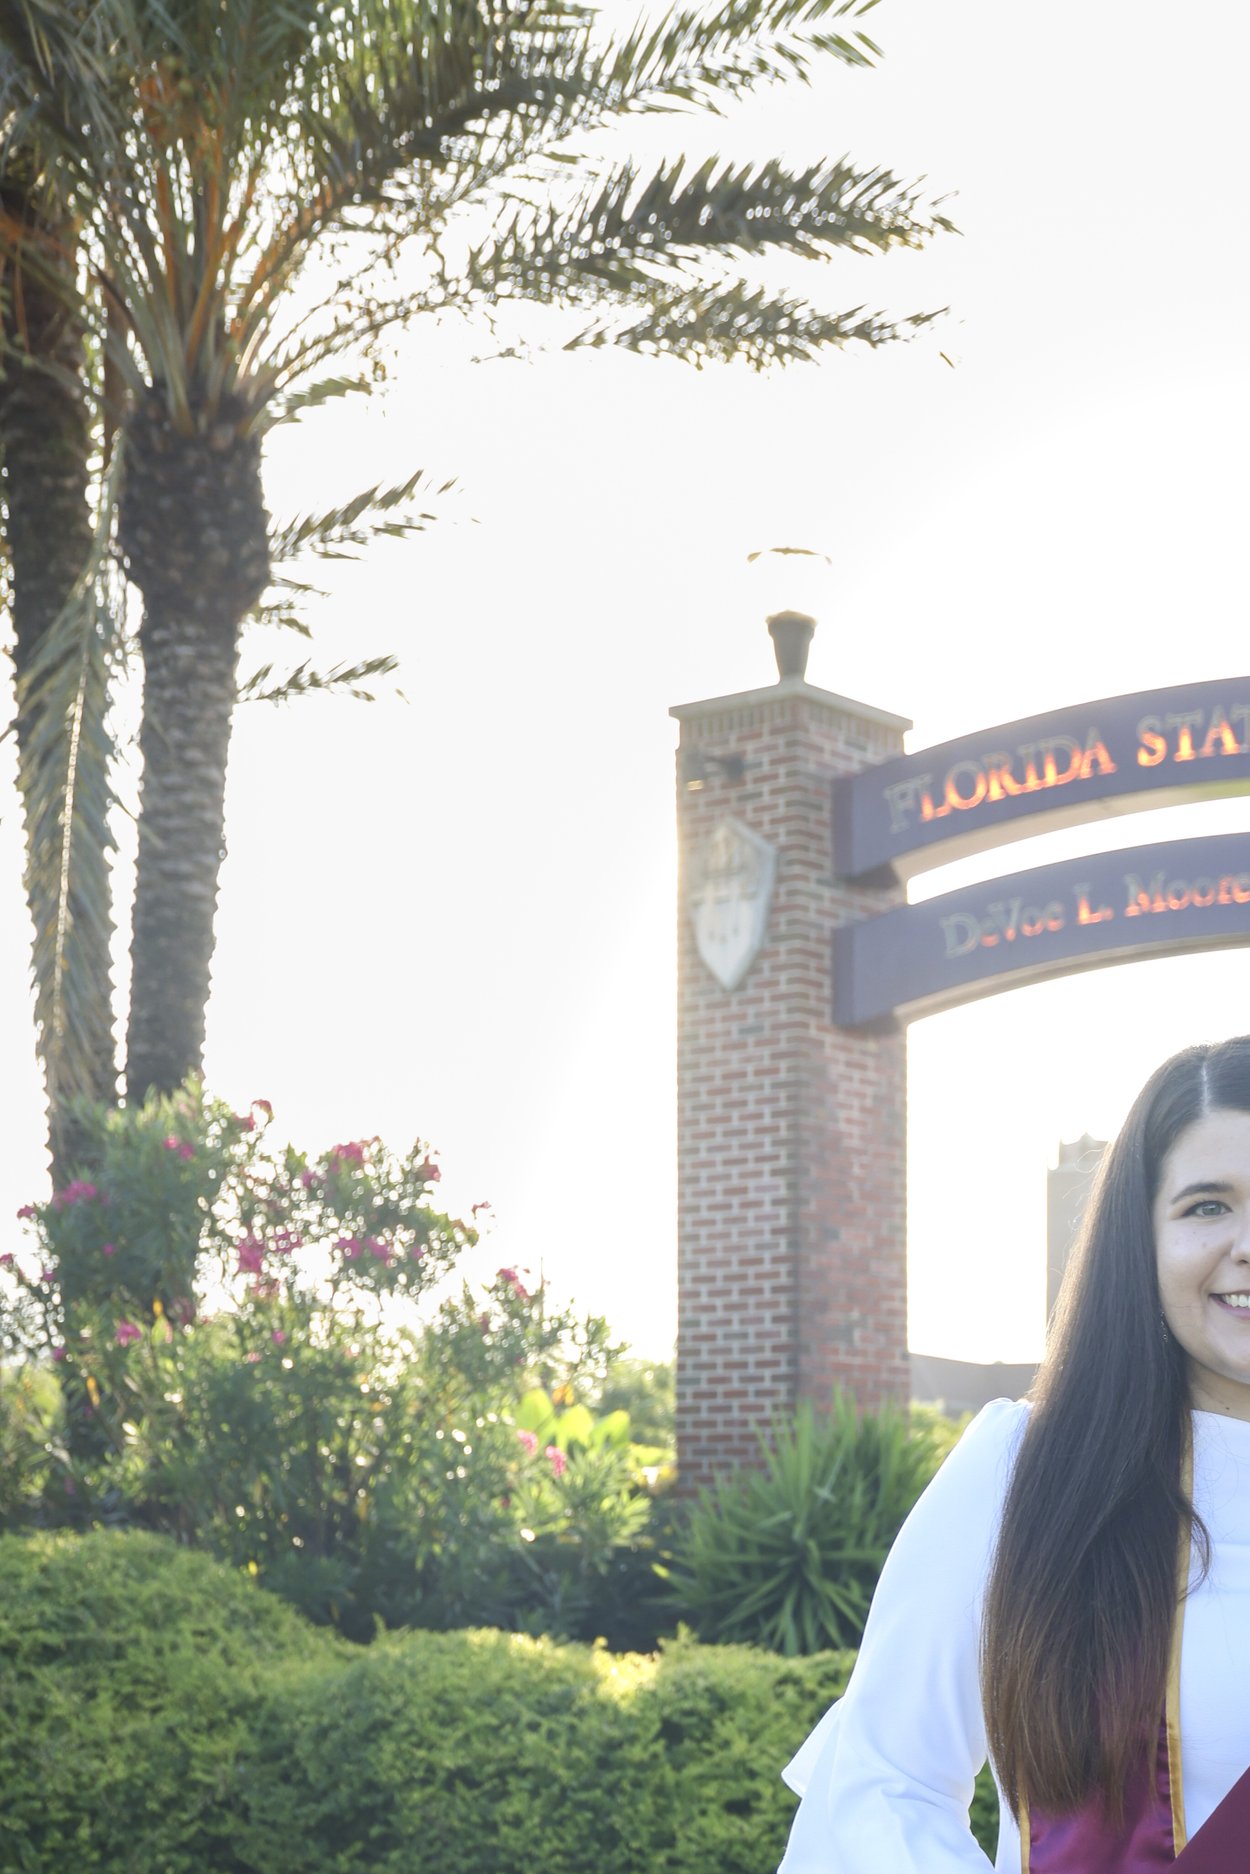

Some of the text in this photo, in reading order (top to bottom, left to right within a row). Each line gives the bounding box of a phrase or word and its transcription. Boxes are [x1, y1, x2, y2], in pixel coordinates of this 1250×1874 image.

[884, 726, 1117, 834] FLORIDA
[939, 897, 1065, 958] DeVoe
[1074, 881, 1114, 925] L.
